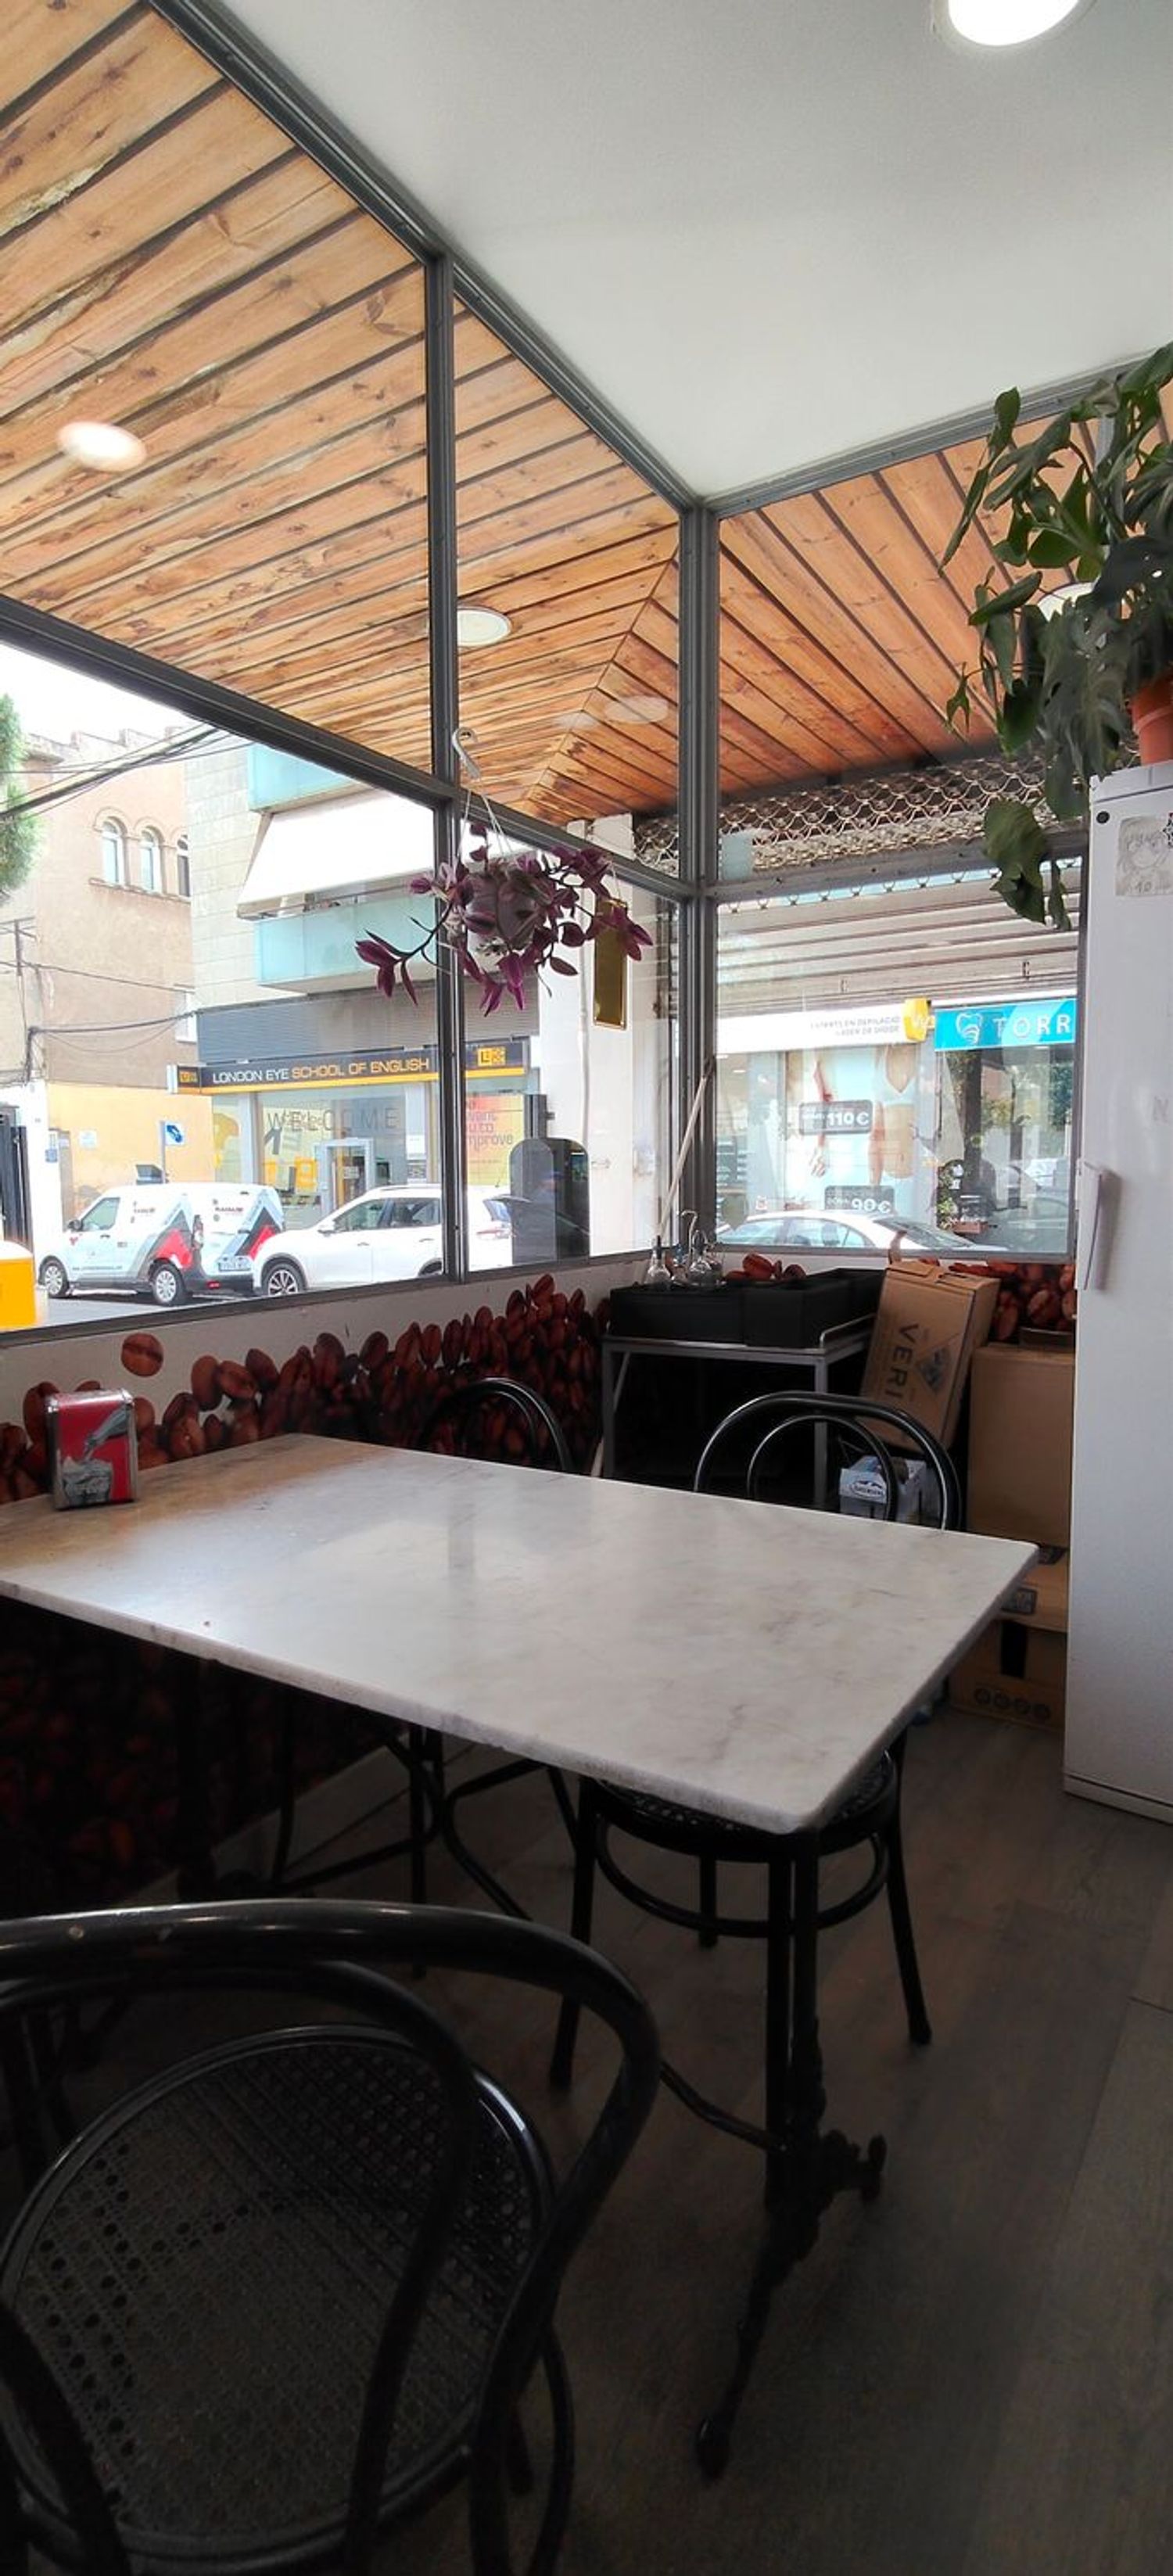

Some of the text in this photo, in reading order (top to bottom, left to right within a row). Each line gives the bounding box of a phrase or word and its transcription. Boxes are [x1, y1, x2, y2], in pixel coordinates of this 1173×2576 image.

[992, 1014, 1071, 1039] TORR
[213, 1070, 263, 1084] LONDON
[266, 1068, 290, 1081] EYE
[292, 1064, 345, 1078] SCHOOL
[349, 1061, 367, 1075] OF
[370, 1058, 429, 1073] ENGLISH
[267, 1107, 399, 1132] WELCOME
[885, 1323, 919, 1398] VERI
